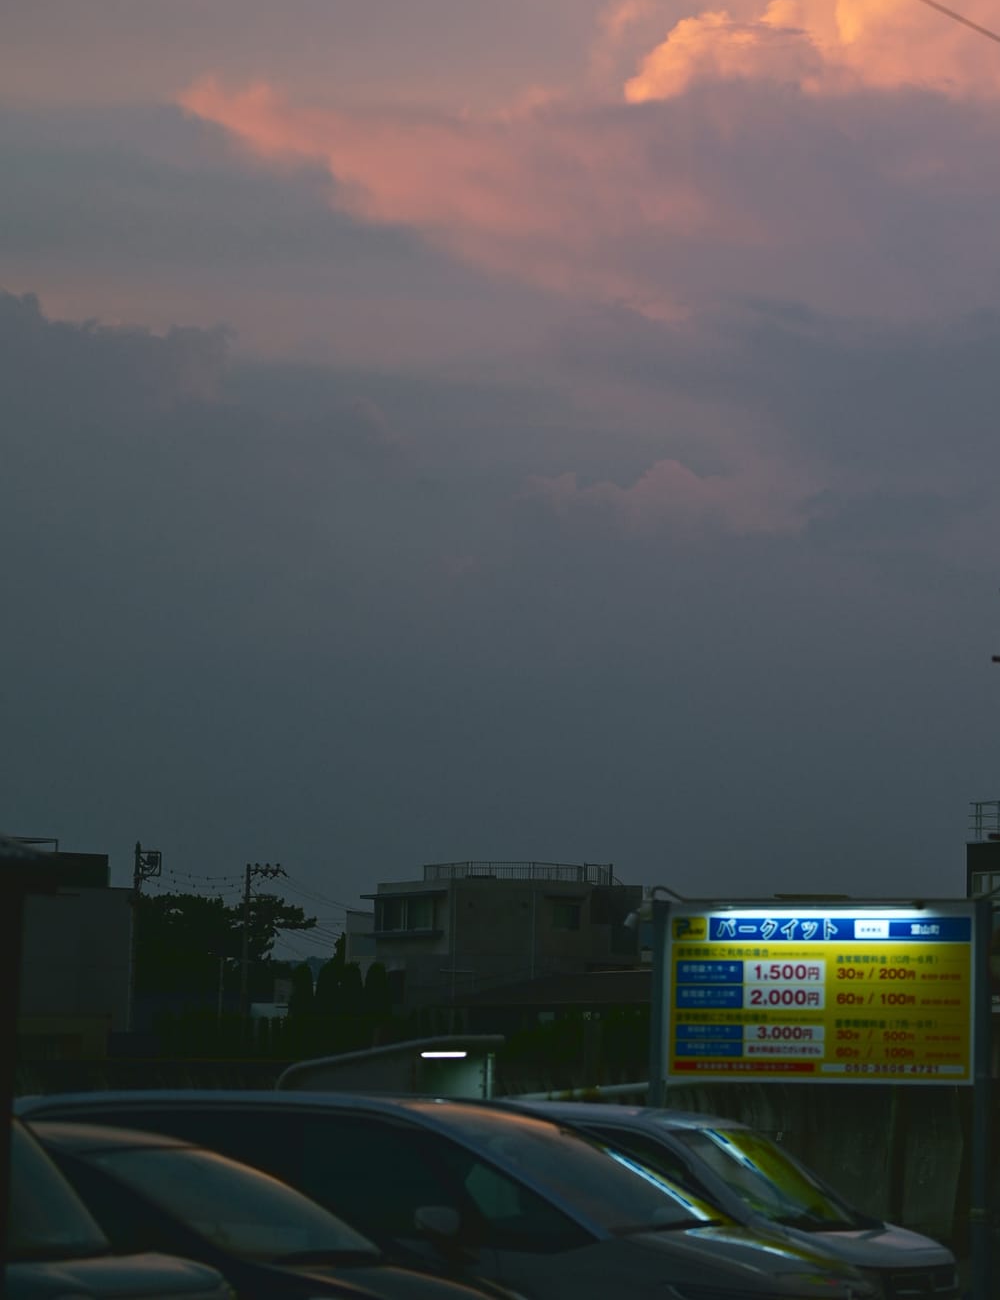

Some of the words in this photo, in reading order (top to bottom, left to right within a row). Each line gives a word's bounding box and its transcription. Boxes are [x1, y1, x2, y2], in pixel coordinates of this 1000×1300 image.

[716, 918, 839, 940] パークイット
